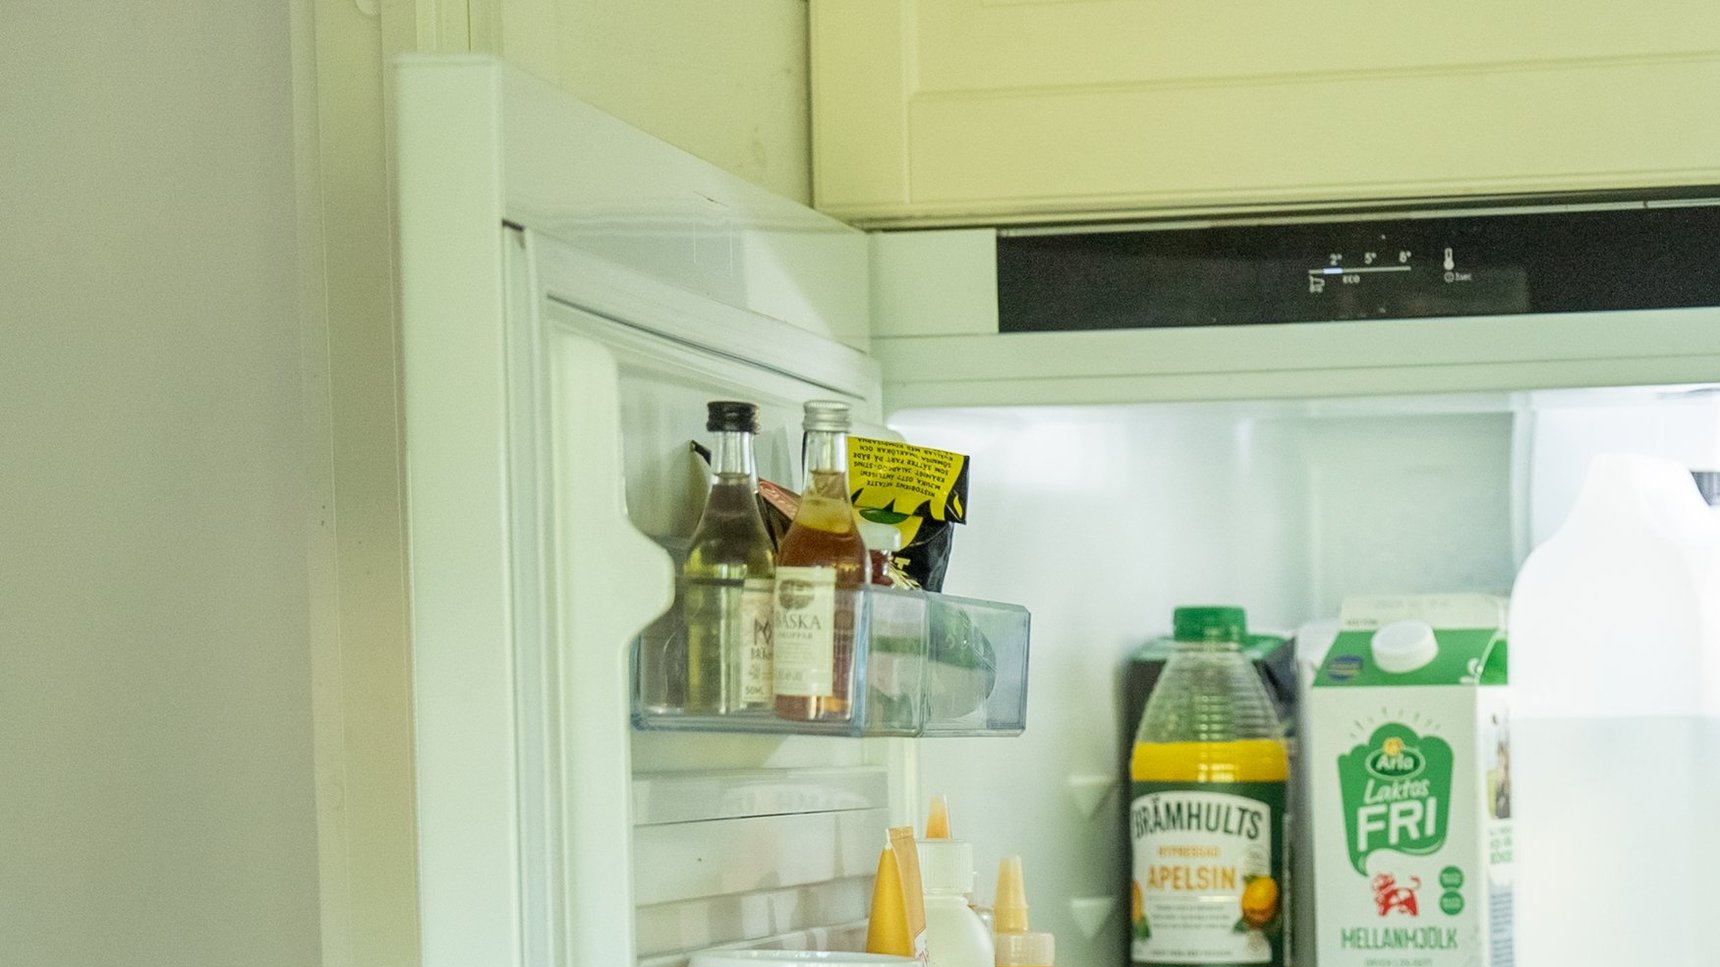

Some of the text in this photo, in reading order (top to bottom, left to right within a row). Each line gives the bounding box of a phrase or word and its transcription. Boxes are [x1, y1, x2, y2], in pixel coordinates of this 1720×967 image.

[1376, 752, 1415, 770] Arla
[1364, 778, 1431, 803] Laktos
[1132, 793, 1262, 841] BRÄMHULTS
[1357, 796, 1437, 852] FRI
[1147, 865, 1236, 891] APELSIN
[1341, 926, 1459, 949] MELLANMJÖLK
